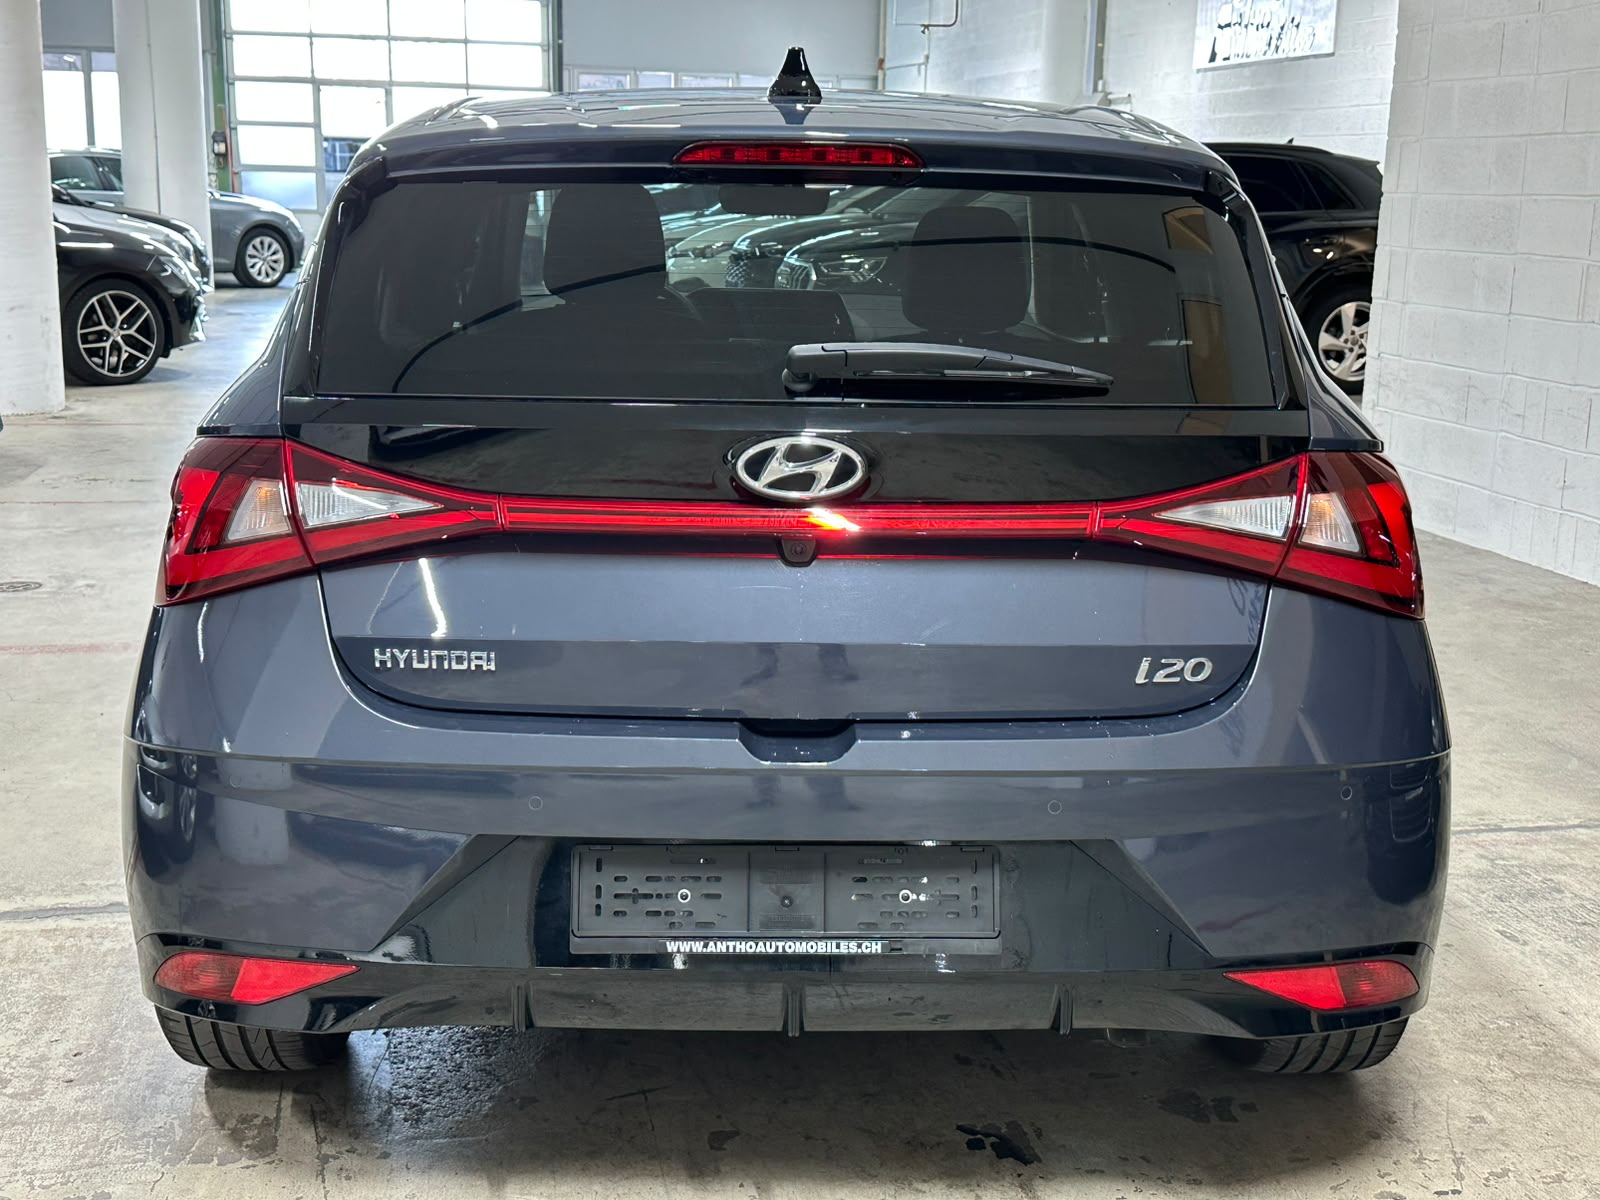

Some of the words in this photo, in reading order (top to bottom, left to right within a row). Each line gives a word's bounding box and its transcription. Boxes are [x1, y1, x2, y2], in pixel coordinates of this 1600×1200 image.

[373, 648, 496, 671] HYUNDAI
[1135, 657, 1214, 684] i20
[666, 941, 882, 953] WWW.ANTHOAUTOMOBILES.CH
